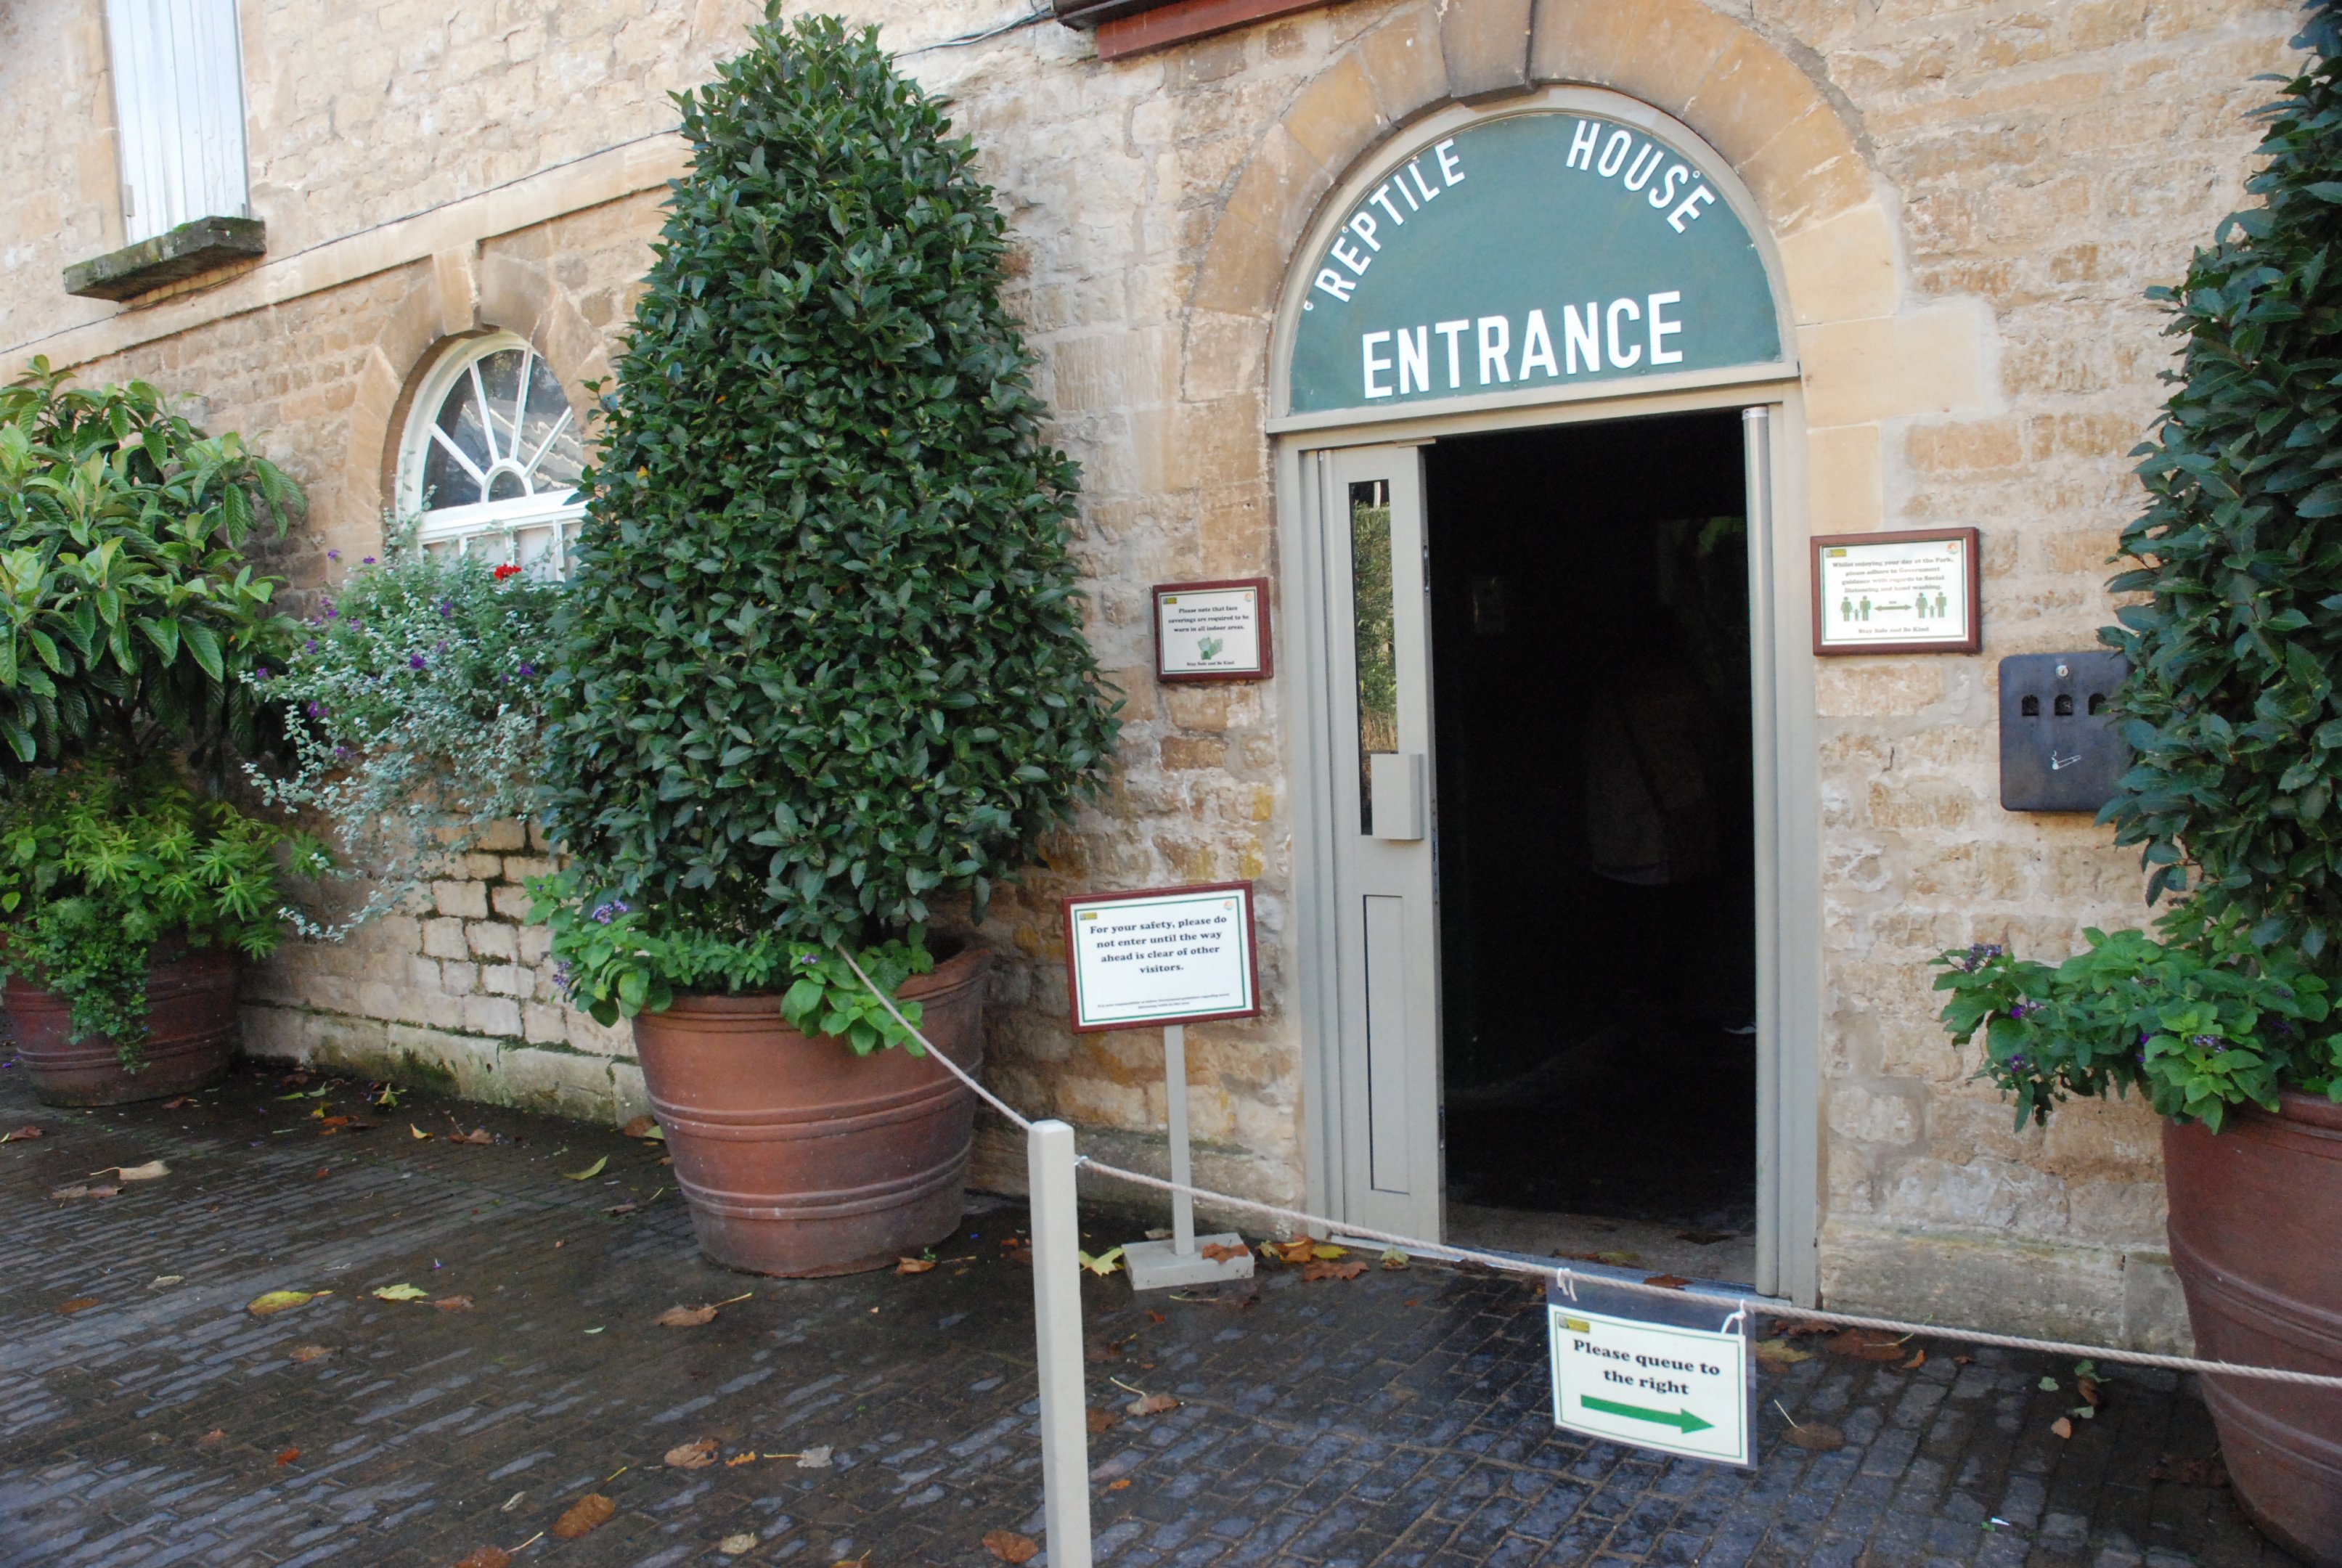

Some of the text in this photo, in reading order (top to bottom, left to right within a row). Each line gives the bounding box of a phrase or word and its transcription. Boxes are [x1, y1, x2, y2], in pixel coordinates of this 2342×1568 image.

[1314, 119, 1716, 302] REPTILE HOUSE
[1362, 290, 1683, 399] ENTRANCE
[1090, 915, 1227, 934] For your safety, please do
[1119, 938, 1146, 947] enter
[1150, 935, 1177, 944] until
[1180, 933, 1197, 942] the
[1101, 953, 1133, 962] ahead
[1148, 950, 1174, 959] clear
[1191, 946, 1220, 955] other
[1140, 965, 1183, 973] visitors.
[1573, 1339, 1720, 1376] Please queue to
[1604, 1370, 1689, 1395] the right
